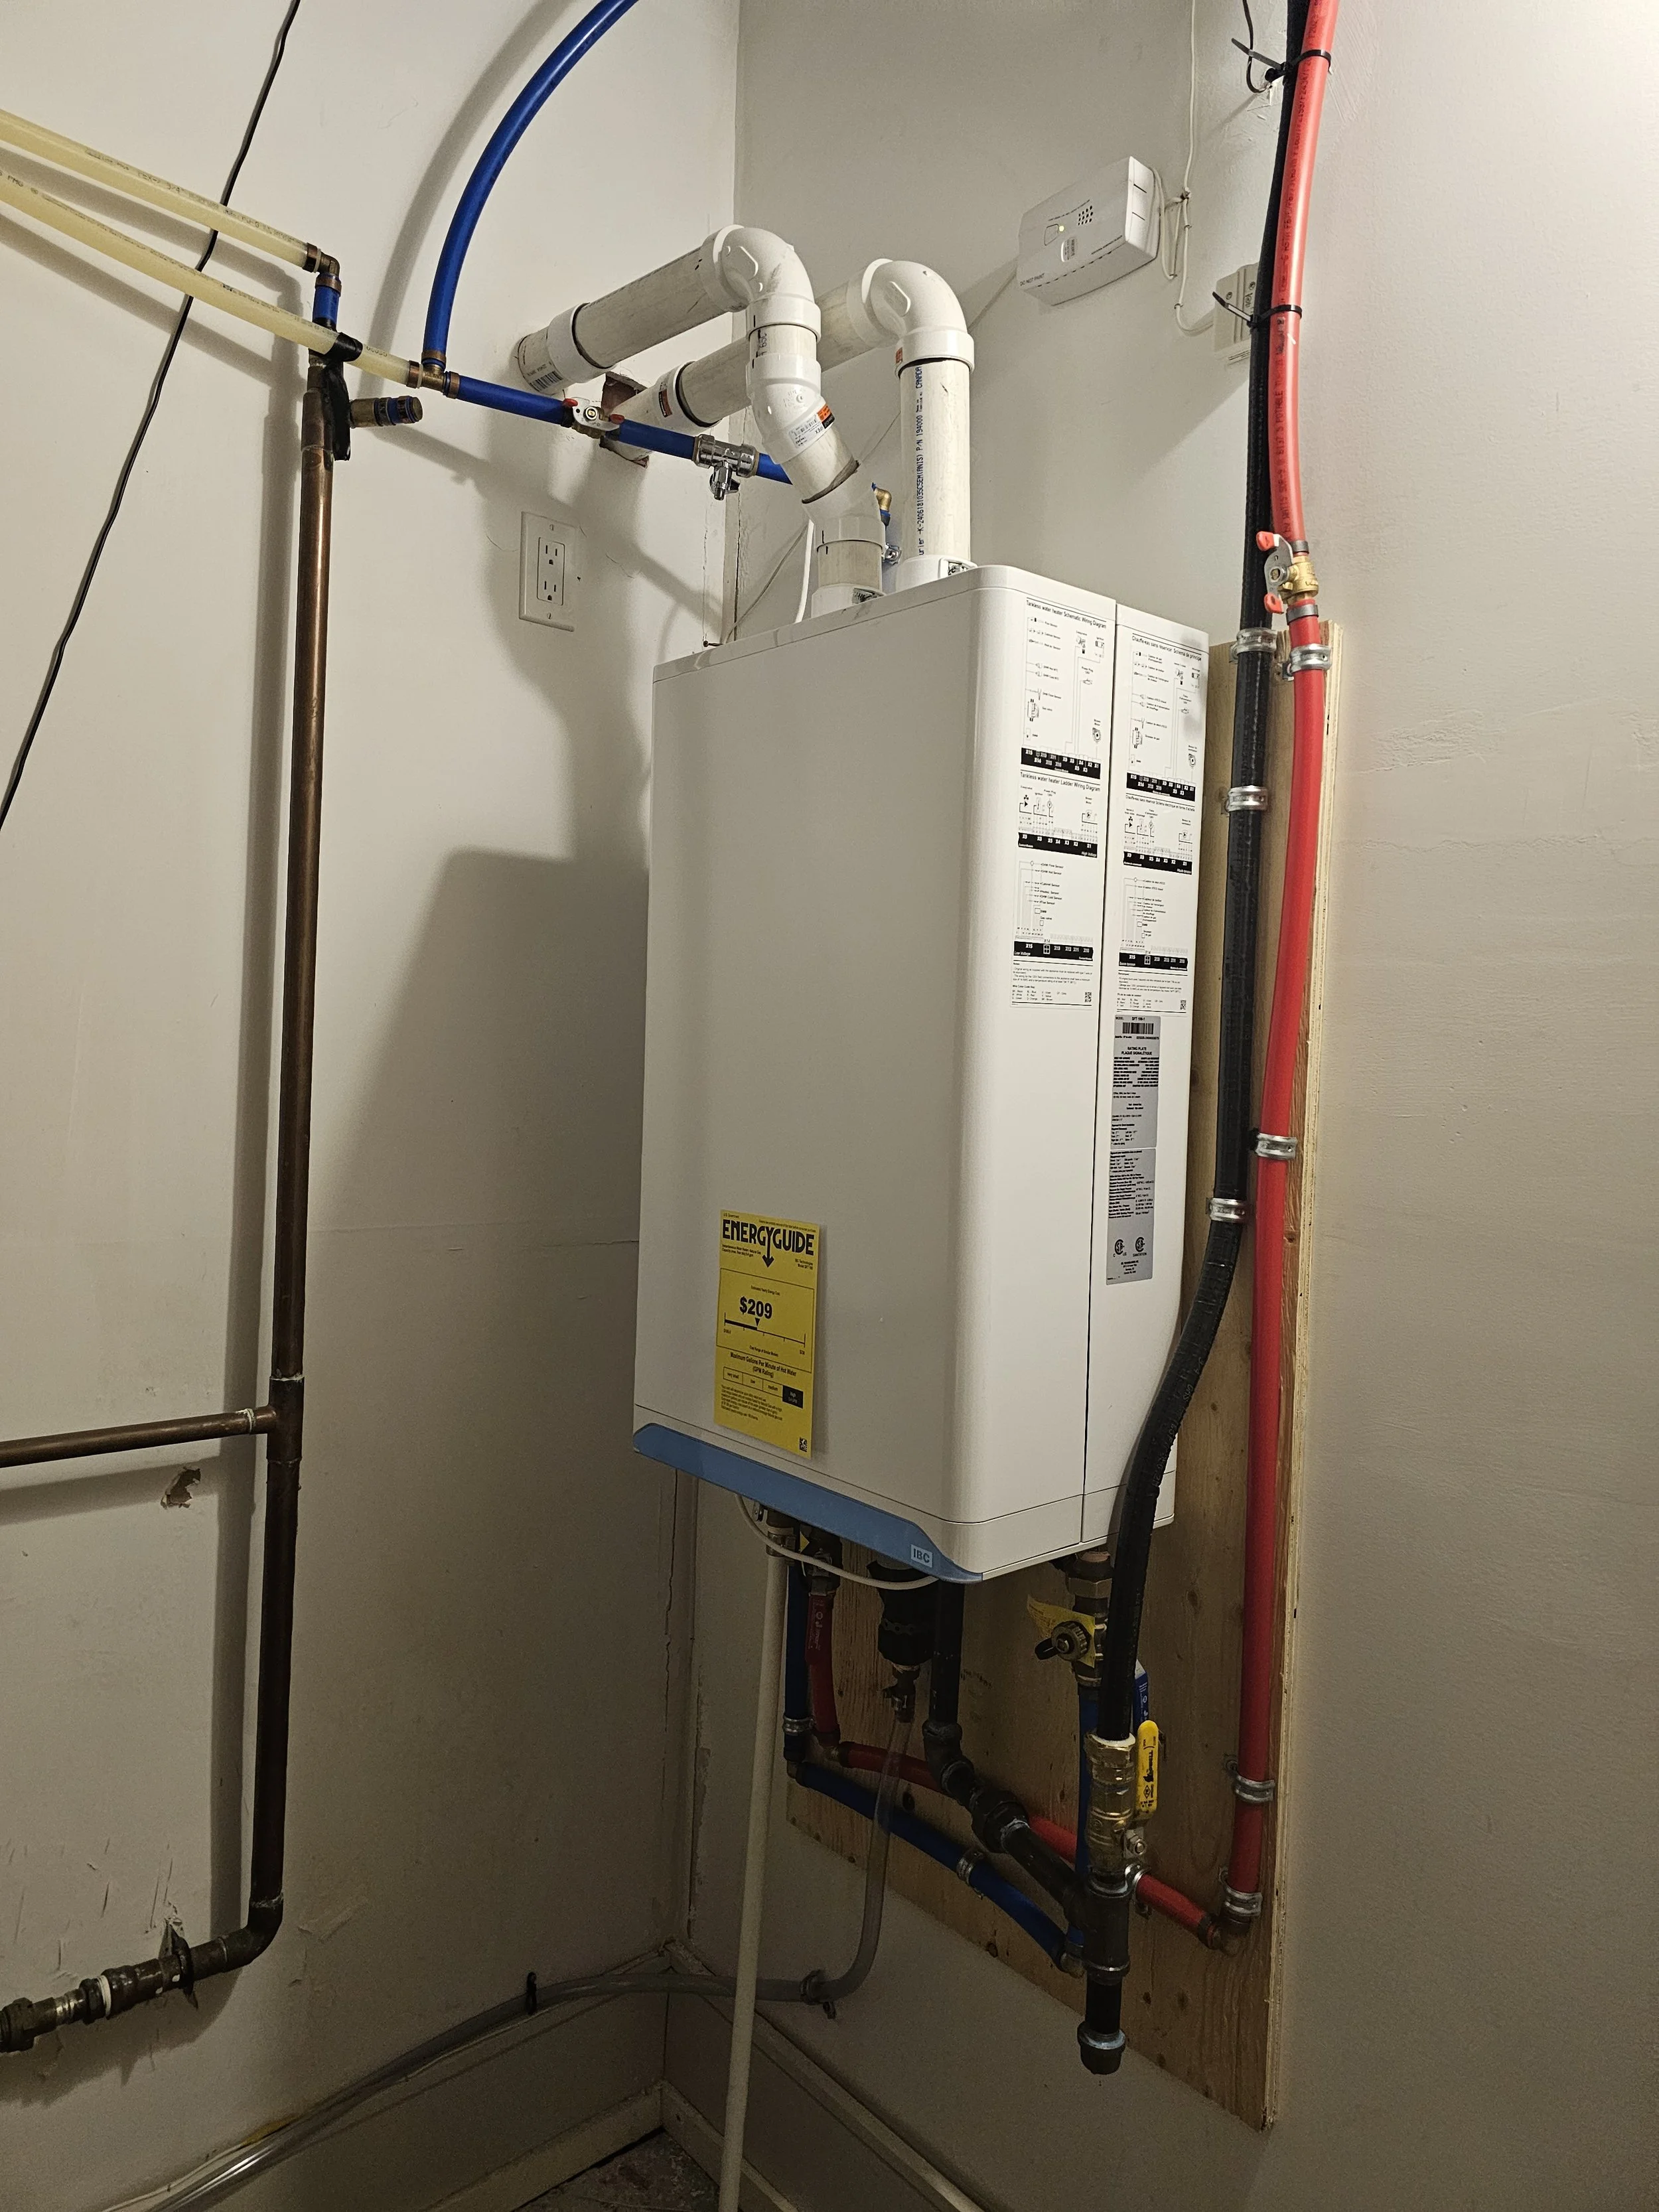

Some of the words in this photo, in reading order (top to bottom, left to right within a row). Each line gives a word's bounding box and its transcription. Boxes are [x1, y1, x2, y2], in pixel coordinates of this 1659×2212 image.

[1027, 600, 1041, 609] Tankless
[723, 1219, 814, 1256] ENERGYGUIDE
[740, 1296, 772, 1319] $209
[731, 1352, 745, 1361] Maximum
[746, 1357, 758, 1365] Gallons
[765, 1361, 776, 1370] Minute
[787, 1368, 796, 1376] Water
[762, 1368, 774, 1378] Rating)
[913, 1548, 930, 1563] IBC
